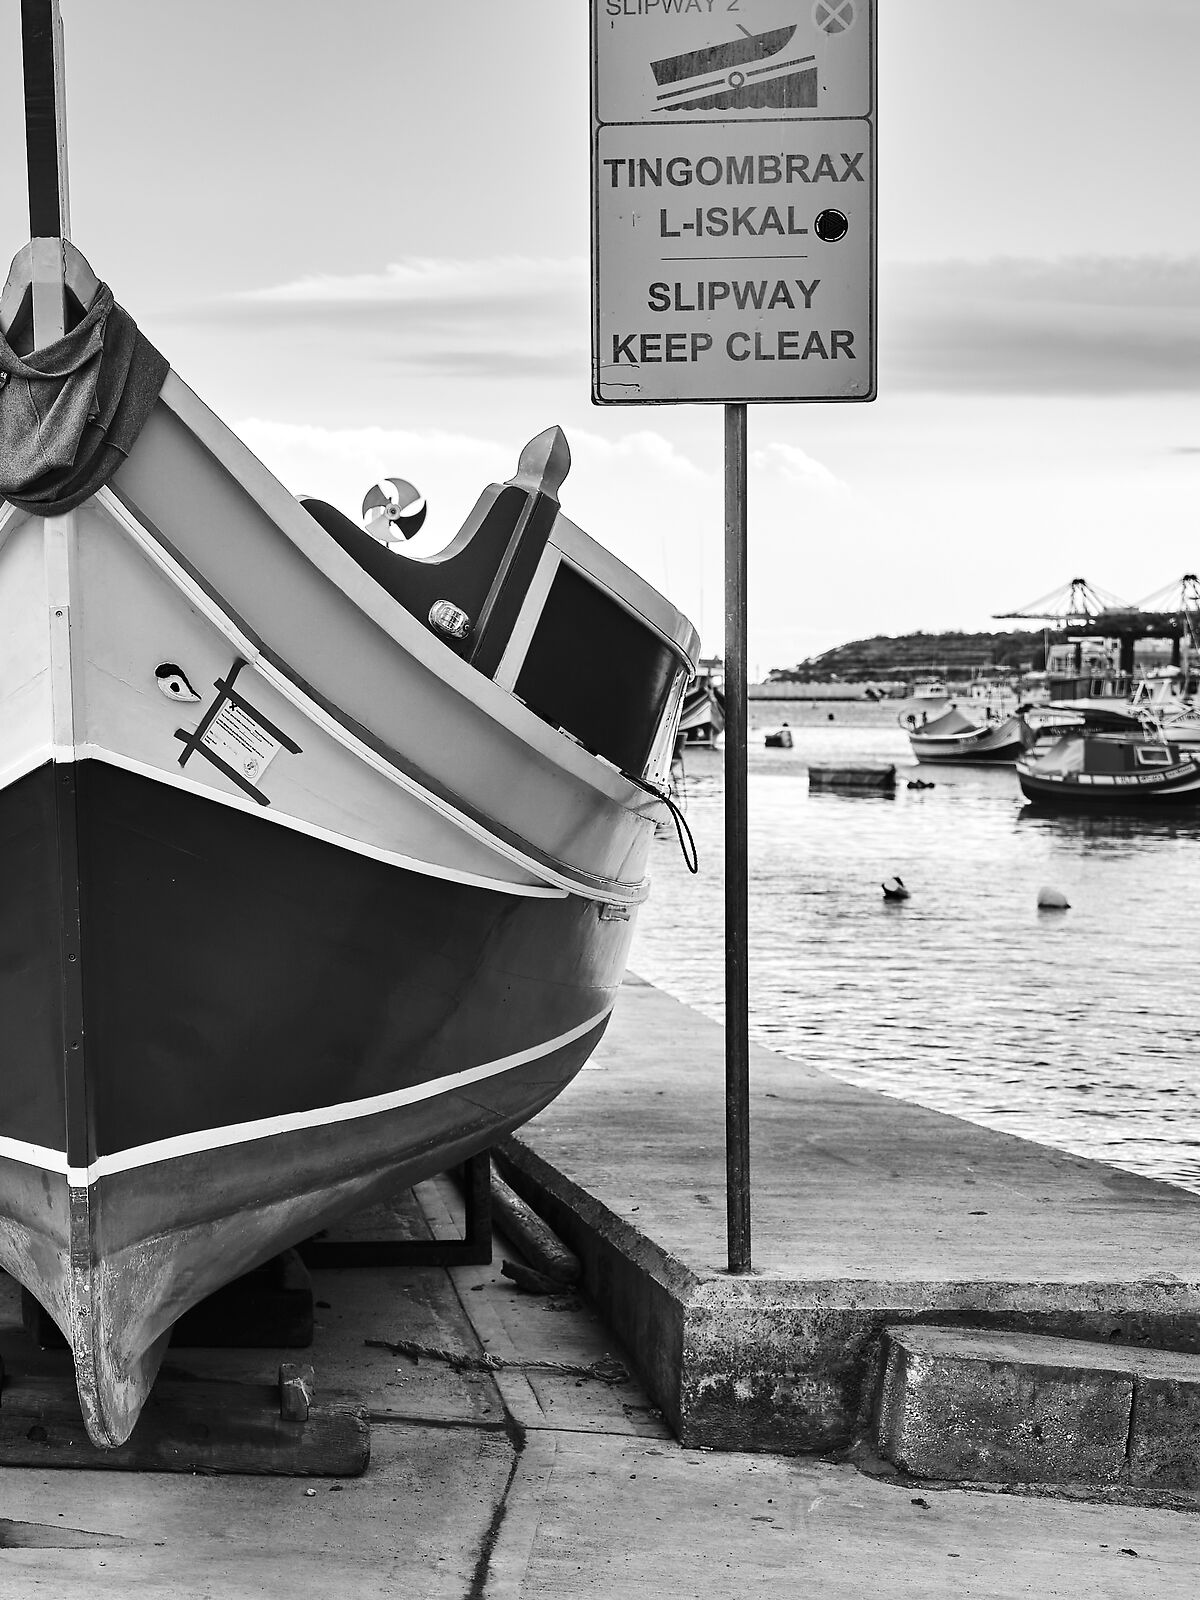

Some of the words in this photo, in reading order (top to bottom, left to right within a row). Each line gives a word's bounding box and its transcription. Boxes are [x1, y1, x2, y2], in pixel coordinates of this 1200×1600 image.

[606, 0, 715, 15] SLIPWAY
[603, 152, 865, 188] TINGOMBRAX
[660, 206, 808, 238] L-ISKAL
[647, 279, 821, 312] SLIPWAY
[612, 332, 713, 363] KEEP
[725, 330, 856, 361] CLEAR
